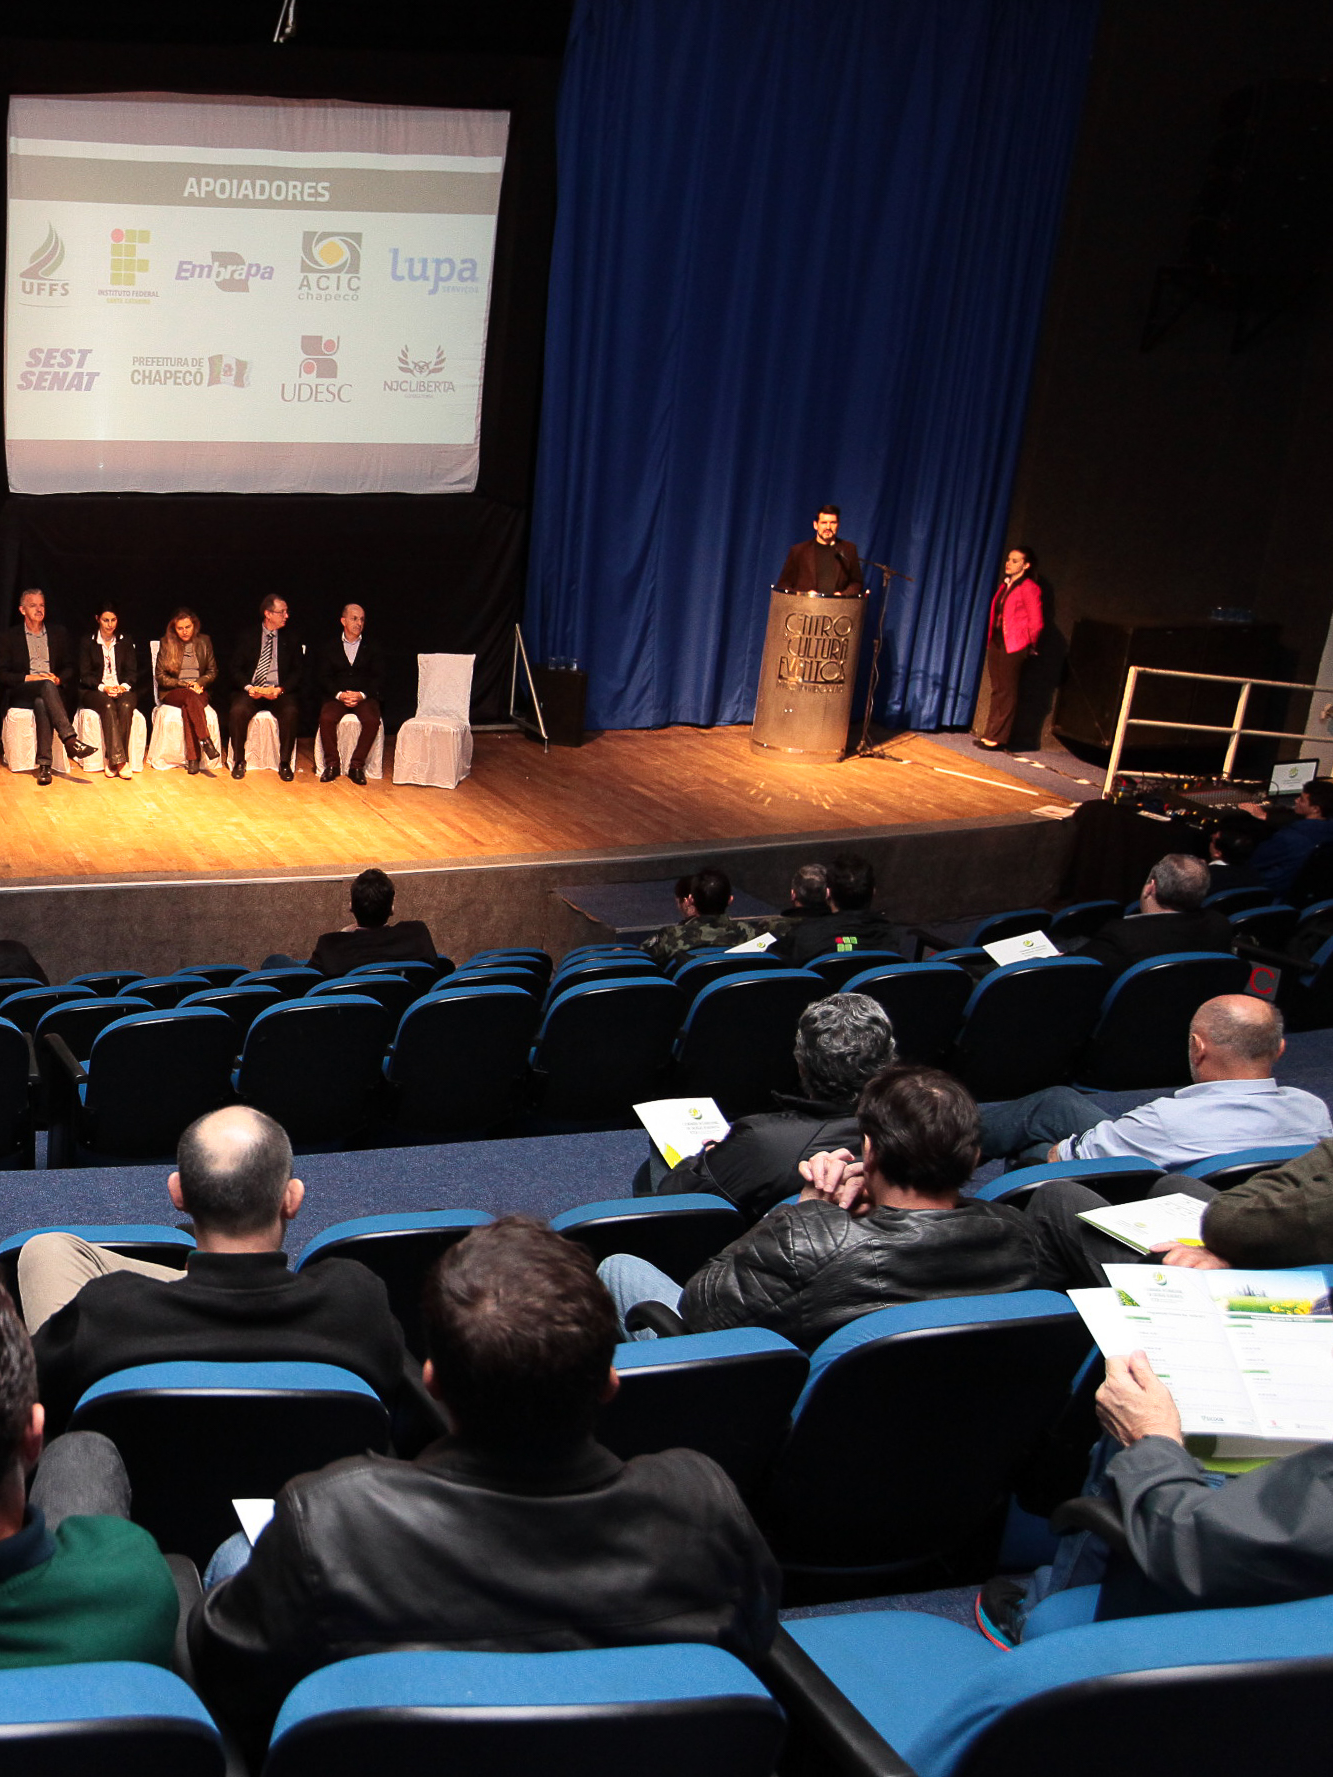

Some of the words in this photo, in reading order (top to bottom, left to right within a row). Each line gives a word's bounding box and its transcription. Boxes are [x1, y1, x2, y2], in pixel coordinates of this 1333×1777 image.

[183, 177, 332, 203] APOIADORES
[175, 260, 275, 282] Embrapa
[389, 248, 479, 295] lupa
[21, 281, 71, 297] UFFS
[132, 290, 160, 298] FEDERAL
[298, 275, 361, 292] ACIC
[25, 348, 93, 369] SEST
[132, 356, 189, 368] PREFEITURA
[191, 357, 205, 368] DE
[17, 371, 100, 392] SENAT
[130, 367, 204, 387] CHAPECÓ
[280, 383, 353, 403] UDESC
[785, 612, 853, 637] CENTRO
[787, 635, 850, 660] CULTURA
[778, 656, 847, 684] EVENTOS
[1250, 967, 1276, 994] C
